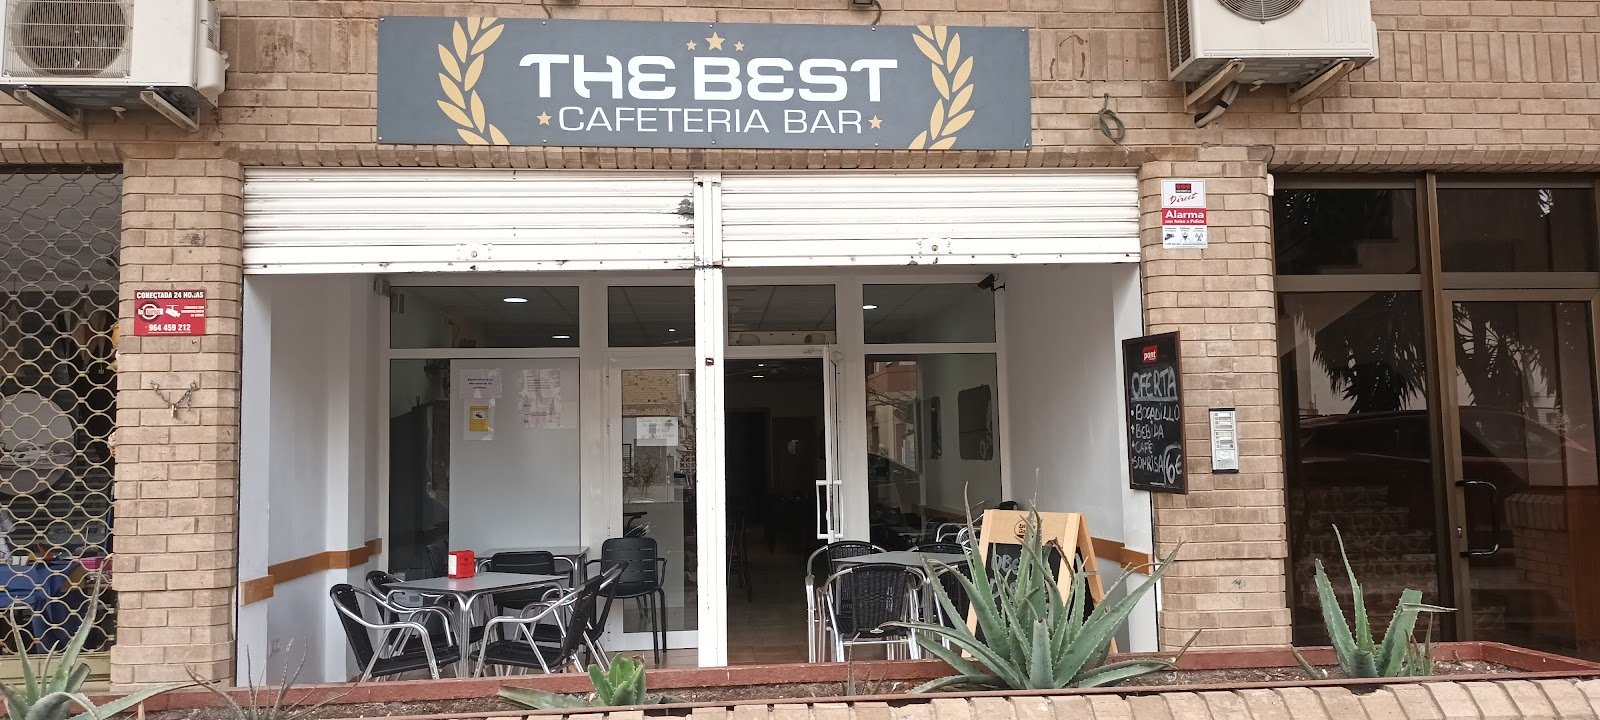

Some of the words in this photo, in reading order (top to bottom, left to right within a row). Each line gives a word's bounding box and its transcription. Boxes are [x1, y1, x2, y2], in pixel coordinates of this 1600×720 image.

[519, 53, 676, 100] THE
[693, 56, 898, 102] BEST
[558, 106, 770, 133] CAFETERIA
[783, 109, 862, 134] BAR
[1165, 210, 1204, 219] Alarma
[136, 291, 173, 299] CONECTADA
[173, 291, 182, 299] 24
[148, 323, 162, 331] 964
[163, 323, 177, 331] 459
[177, 323, 191, 331] 212
[1131, 366, 1177, 399] OFERTA
